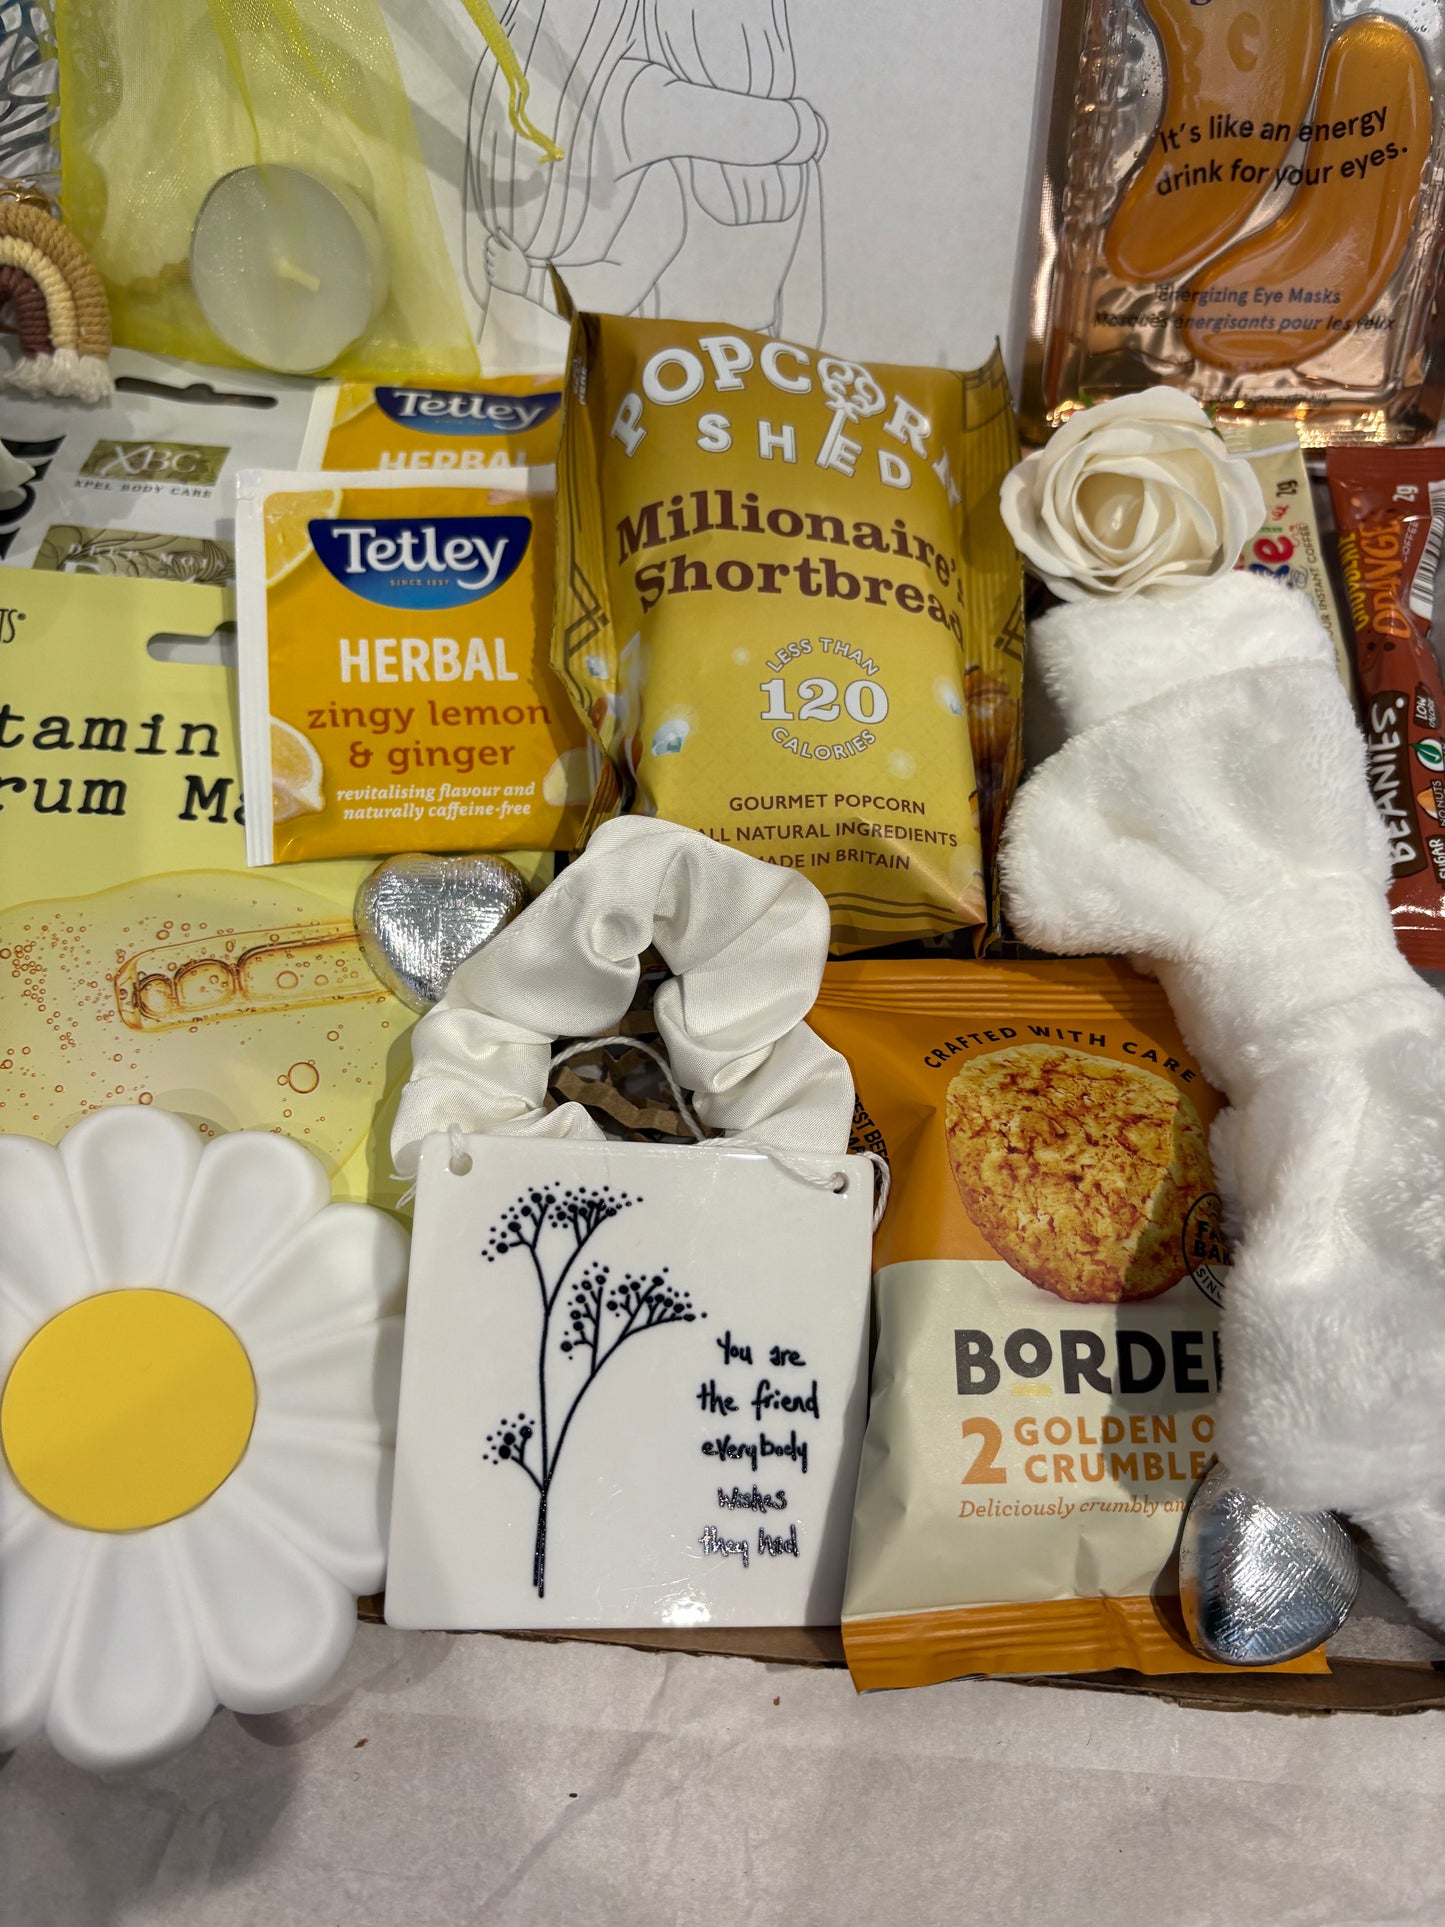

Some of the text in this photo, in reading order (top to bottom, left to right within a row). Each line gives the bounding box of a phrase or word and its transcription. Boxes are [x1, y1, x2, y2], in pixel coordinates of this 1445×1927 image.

[1160, 106, 1387, 153] It's like an energy
[1156, 142, 1408, 196] drink for your eyes.
[1156, 286, 1340, 307] Energizing Eye Masks
[1278, 316, 1322, 334] pour
[1326, 313, 1350, 331] les
[392, 389, 544, 431] Tetley
[101, 443, 201, 477] XBC
[696, 413, 912, 489] SHED
[74, 480, 213, 499] XPEL BODY CARE
[1276, 479, 1299, 499] 2g
[1392, 484, 1419, 502] 2g
[331, 525, 510, 590] Tetley
[1311, 568, 1329, 611] INSTANT
[339, 636, 518, 683] HERBAL
[765, 637, 880, 676] LESS THAN
[308, 700, 552, 733] zingy lemon
[760, 677, 889, 724] 120
[1416, 695, 1428, 721] LOW
[349, 741, 515, 774] & ginger
[772, 726, 876, 760] CALORIES
[337, 781, 536, 801] revitalising flavour and
[729, 794, 925, 815] GOURMET POPCORN
[344, 800, 531, 821] naturally caffeine-free
[736, 823, 830, 842] NATURAL
[836, 822, 958, 848] INGREDIENTS
[811, 851, 830, 867] IN
[836, 849, 910, 870] BRITAIN
[923, 1024, 1196, 1084] CRAFTED WITH CARE
[717, 1330, 806, 1366] You are
[954, 1327, 1223, 1396] BORDE
[696, 1379, 820, 1421] the friend
[1013, 1415, 1177, 1446] GOLDEN
[961, 1416, 1008, 1486] 2
[1024, 1450, 1219, 1484] CRUMBLE
[958, 1496, 1075, 1519] Deliciously
[1079, 1493, 1160, 1518] crumbly
[698, 1524, 800, 1568] they had
